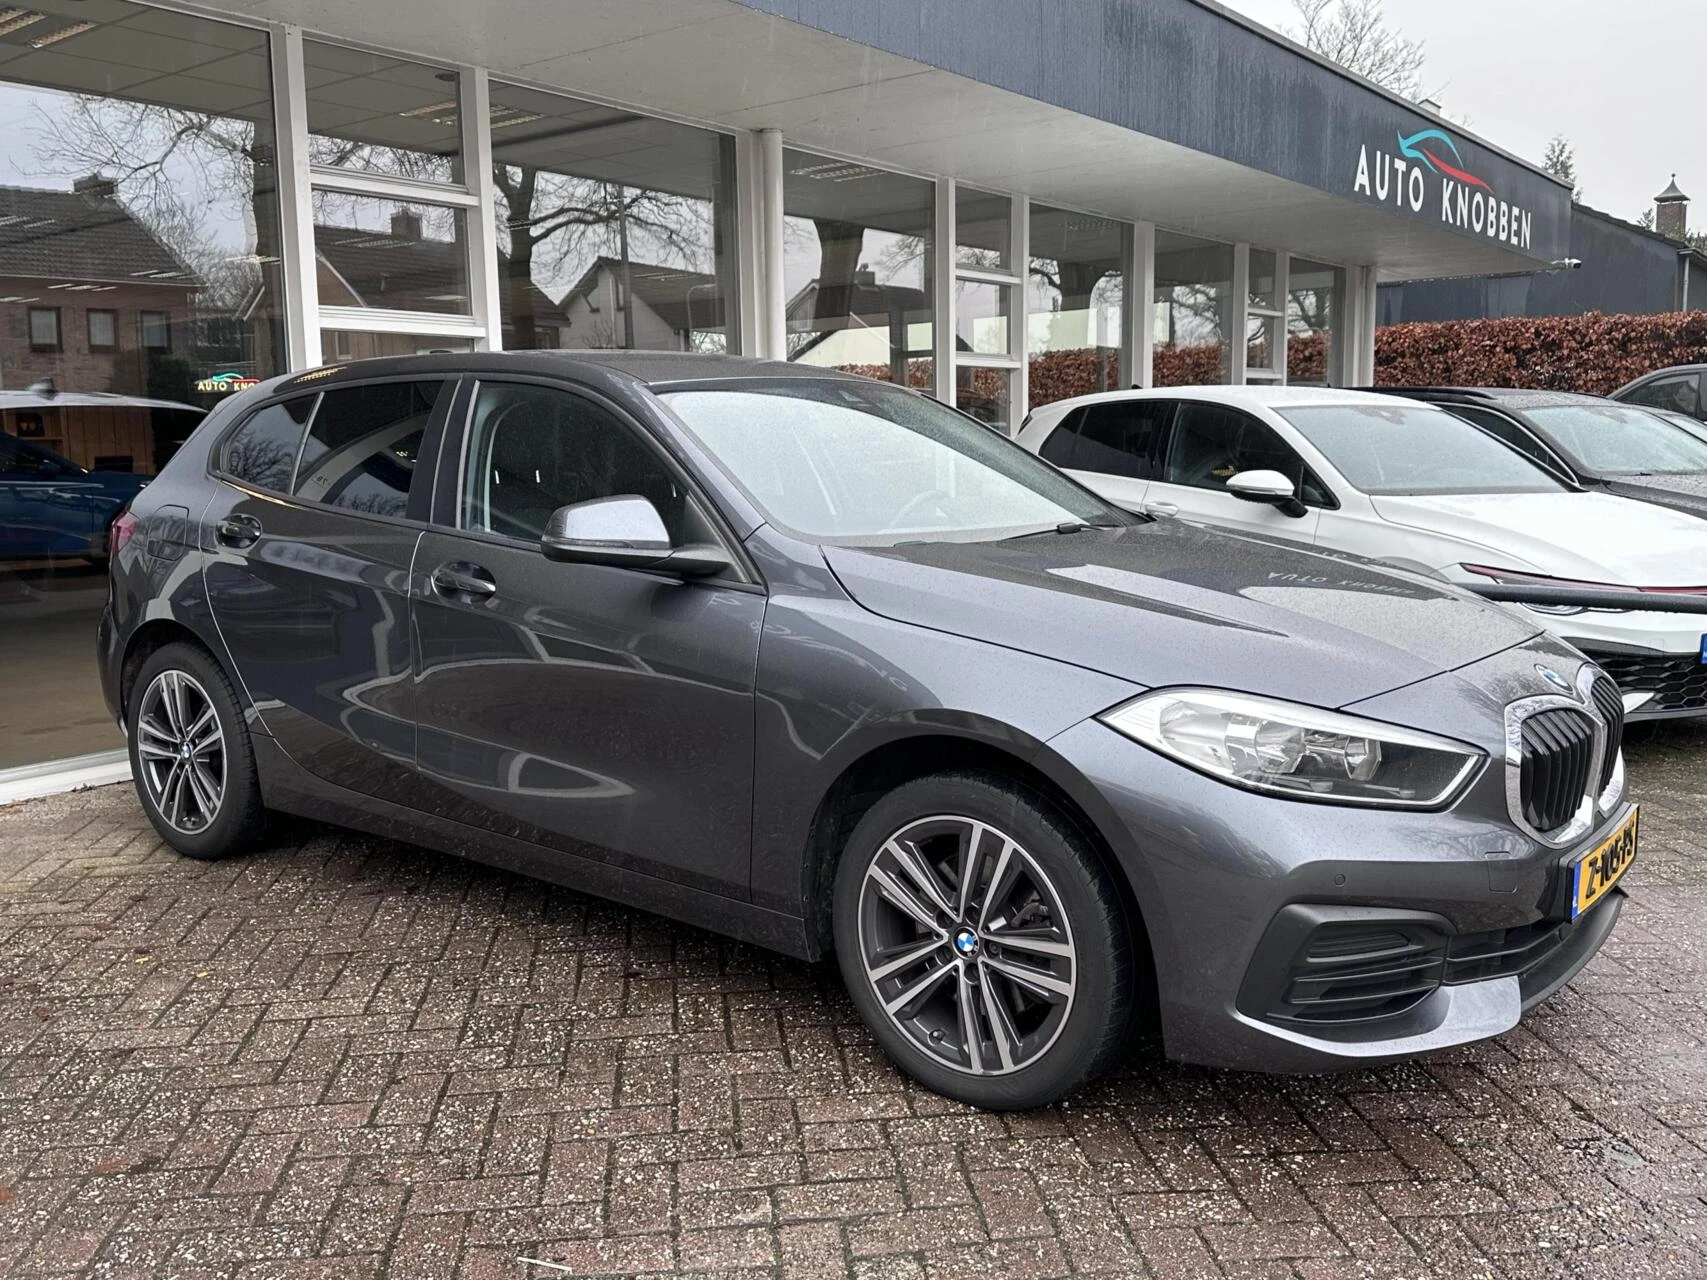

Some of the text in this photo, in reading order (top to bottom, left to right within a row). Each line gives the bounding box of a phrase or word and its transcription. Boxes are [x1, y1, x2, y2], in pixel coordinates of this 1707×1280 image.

[1353, 143, 1532, 250] AUTO KNOBBEN
[197, 381, 228, 391] AUTO
